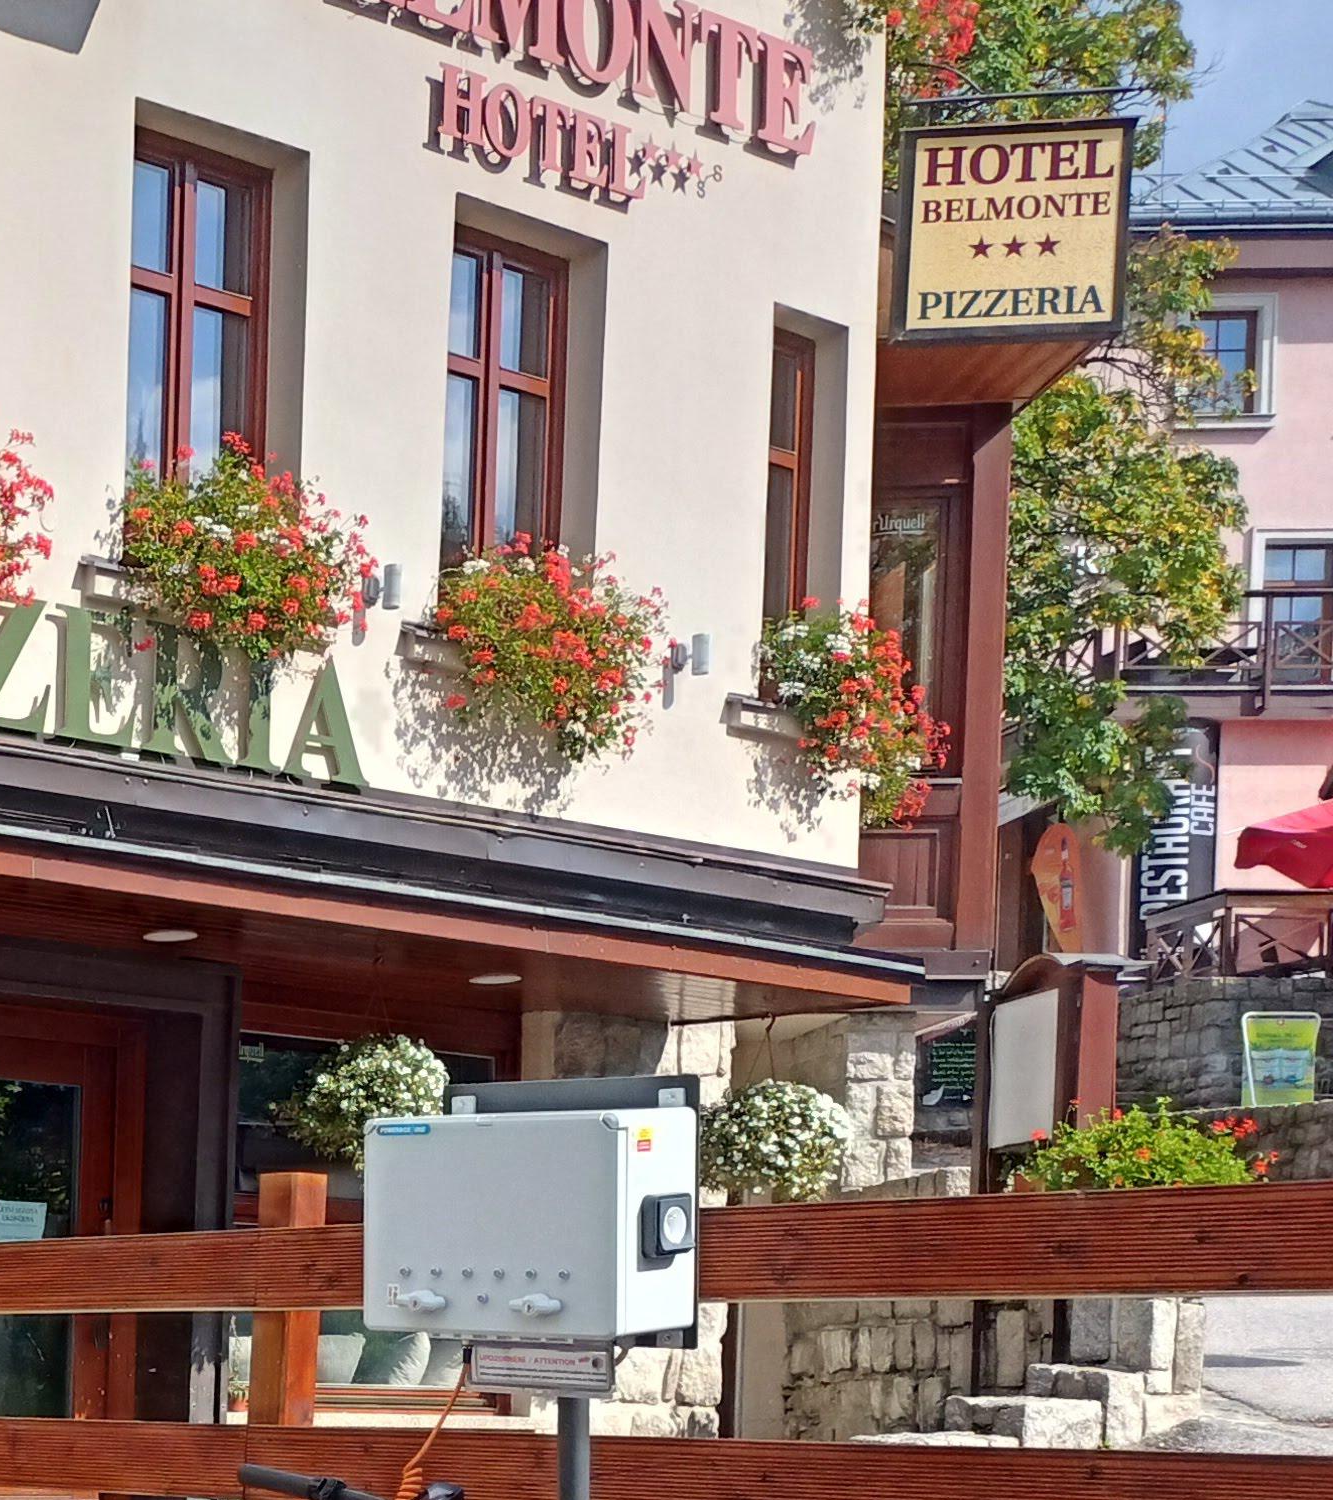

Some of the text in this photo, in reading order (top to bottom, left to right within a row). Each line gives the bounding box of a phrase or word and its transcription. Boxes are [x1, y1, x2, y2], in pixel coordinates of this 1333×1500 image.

[380, 0, 817, 156] MONTE
[438, 62, 646, 200] HOTEL
[922, 139, 1114, 187] HOTEL
[921, 191, 1111, 224] BELMONTE
[917, 285, 1105, 320] PIZZERIA
[878, 513, 925, 538] Urquell
